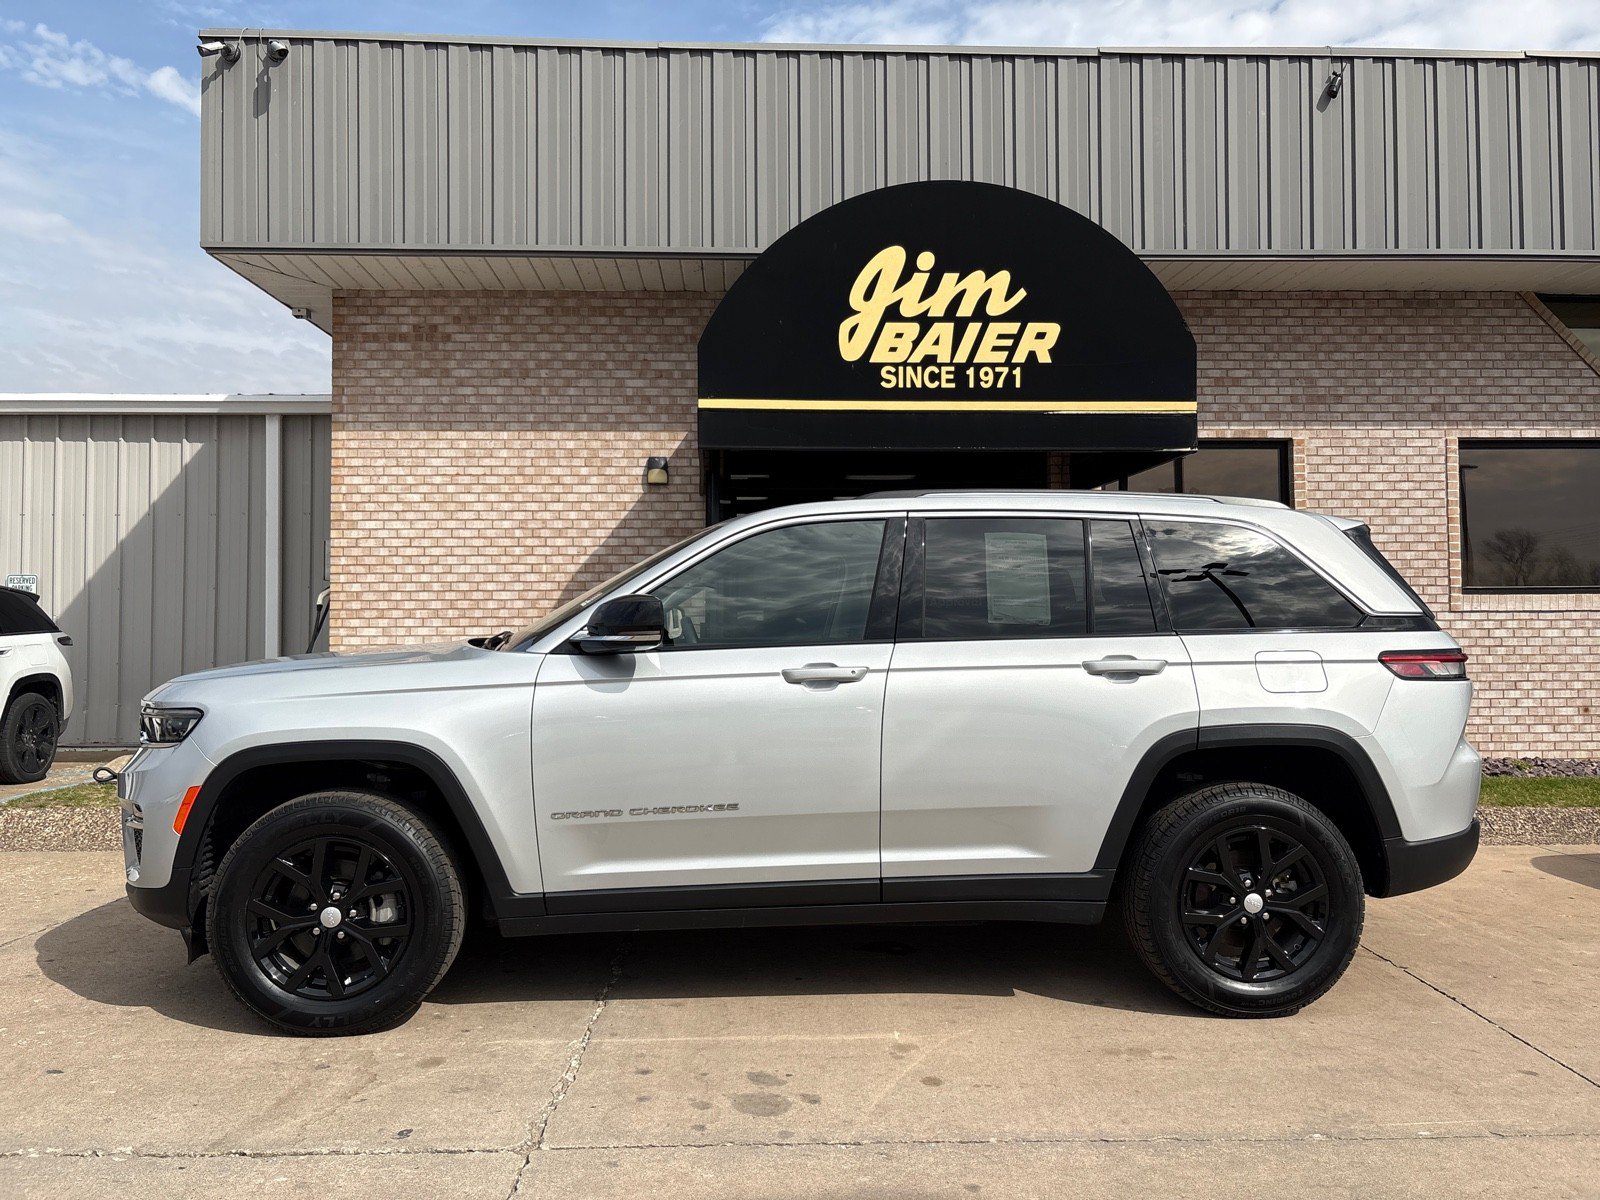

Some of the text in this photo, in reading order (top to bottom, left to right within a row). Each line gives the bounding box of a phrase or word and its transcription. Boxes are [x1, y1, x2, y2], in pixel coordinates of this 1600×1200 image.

[838, 245, 1028, 362] Jim
[869, 322, 1062, 364] BAIER
[880, 365, 1022, 389] SINCE 1971
[9, 577, 36, 585] RESERVED
[550, 803, 740, 820] GRAND CHEROKEE
